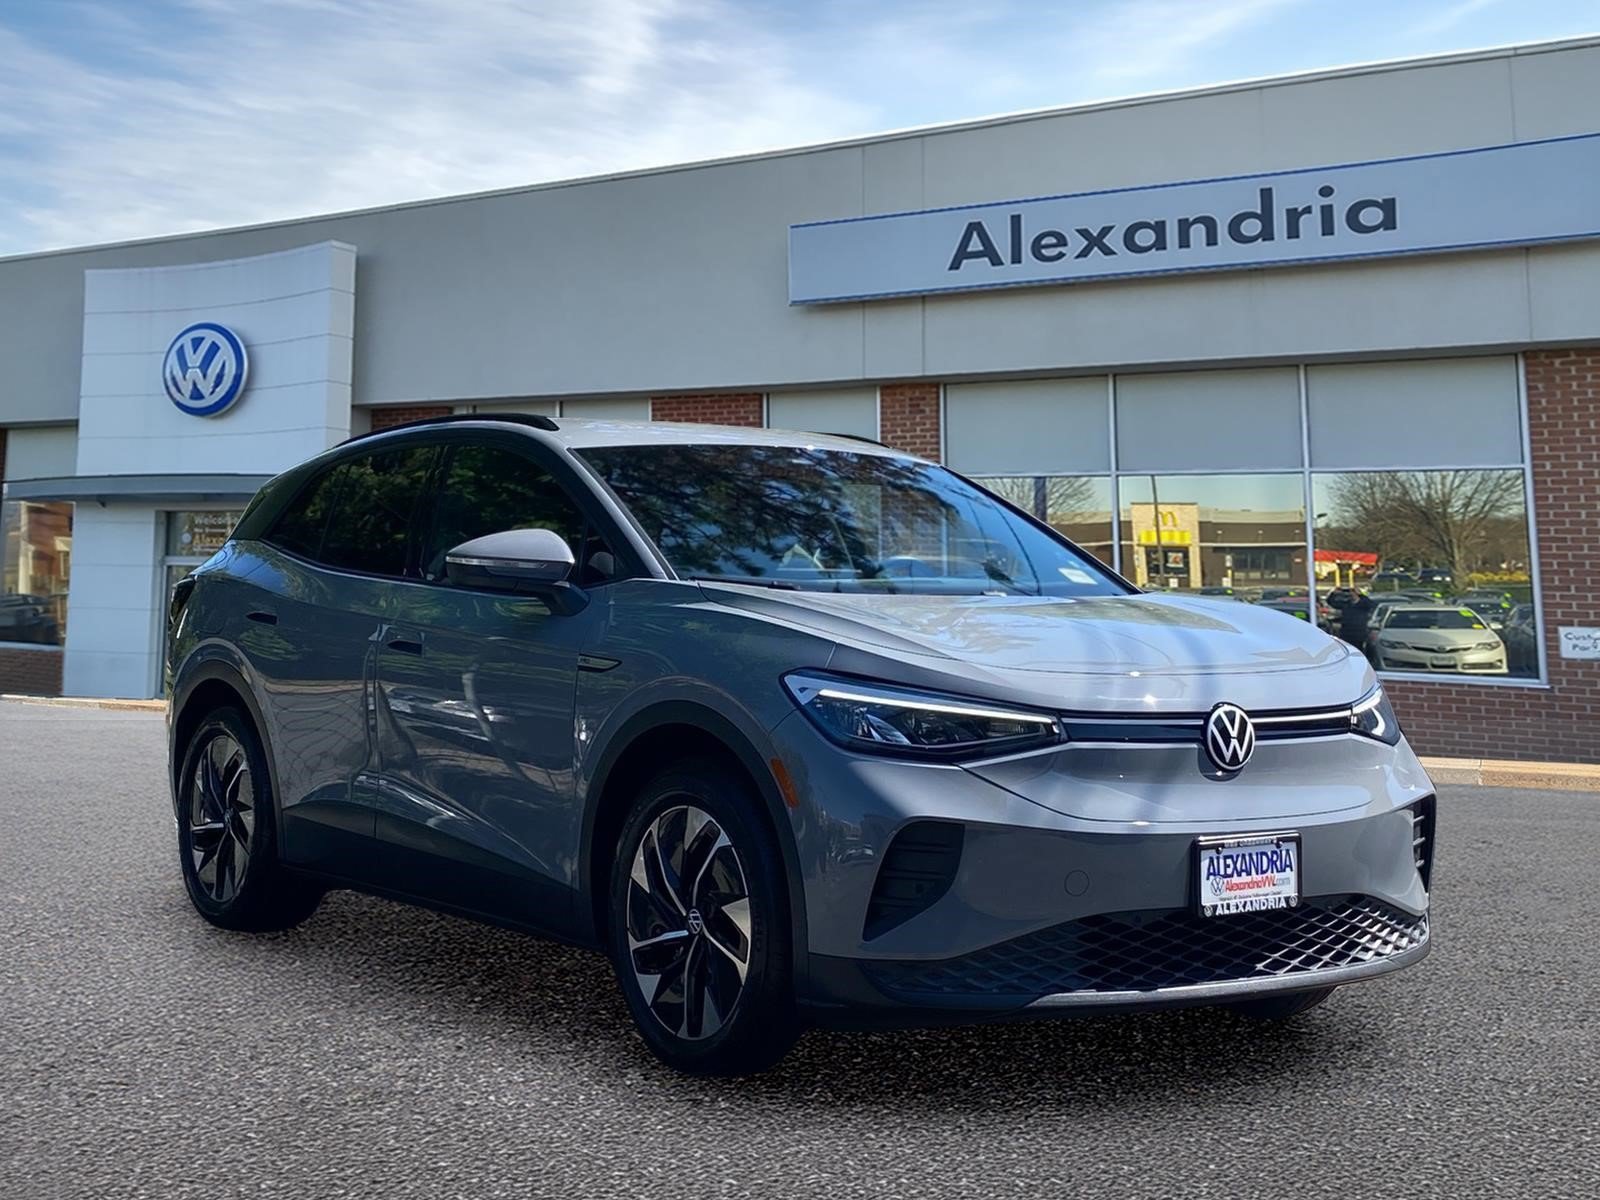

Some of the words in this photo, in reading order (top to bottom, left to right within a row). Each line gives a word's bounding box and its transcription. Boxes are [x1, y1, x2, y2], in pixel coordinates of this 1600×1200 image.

[947, 185, 1398, 272] Alexandria
[1206, 848, 1294, 881] ALEXANDRIA
[1215, 895, 1287, 916] ALEXANDRIA
